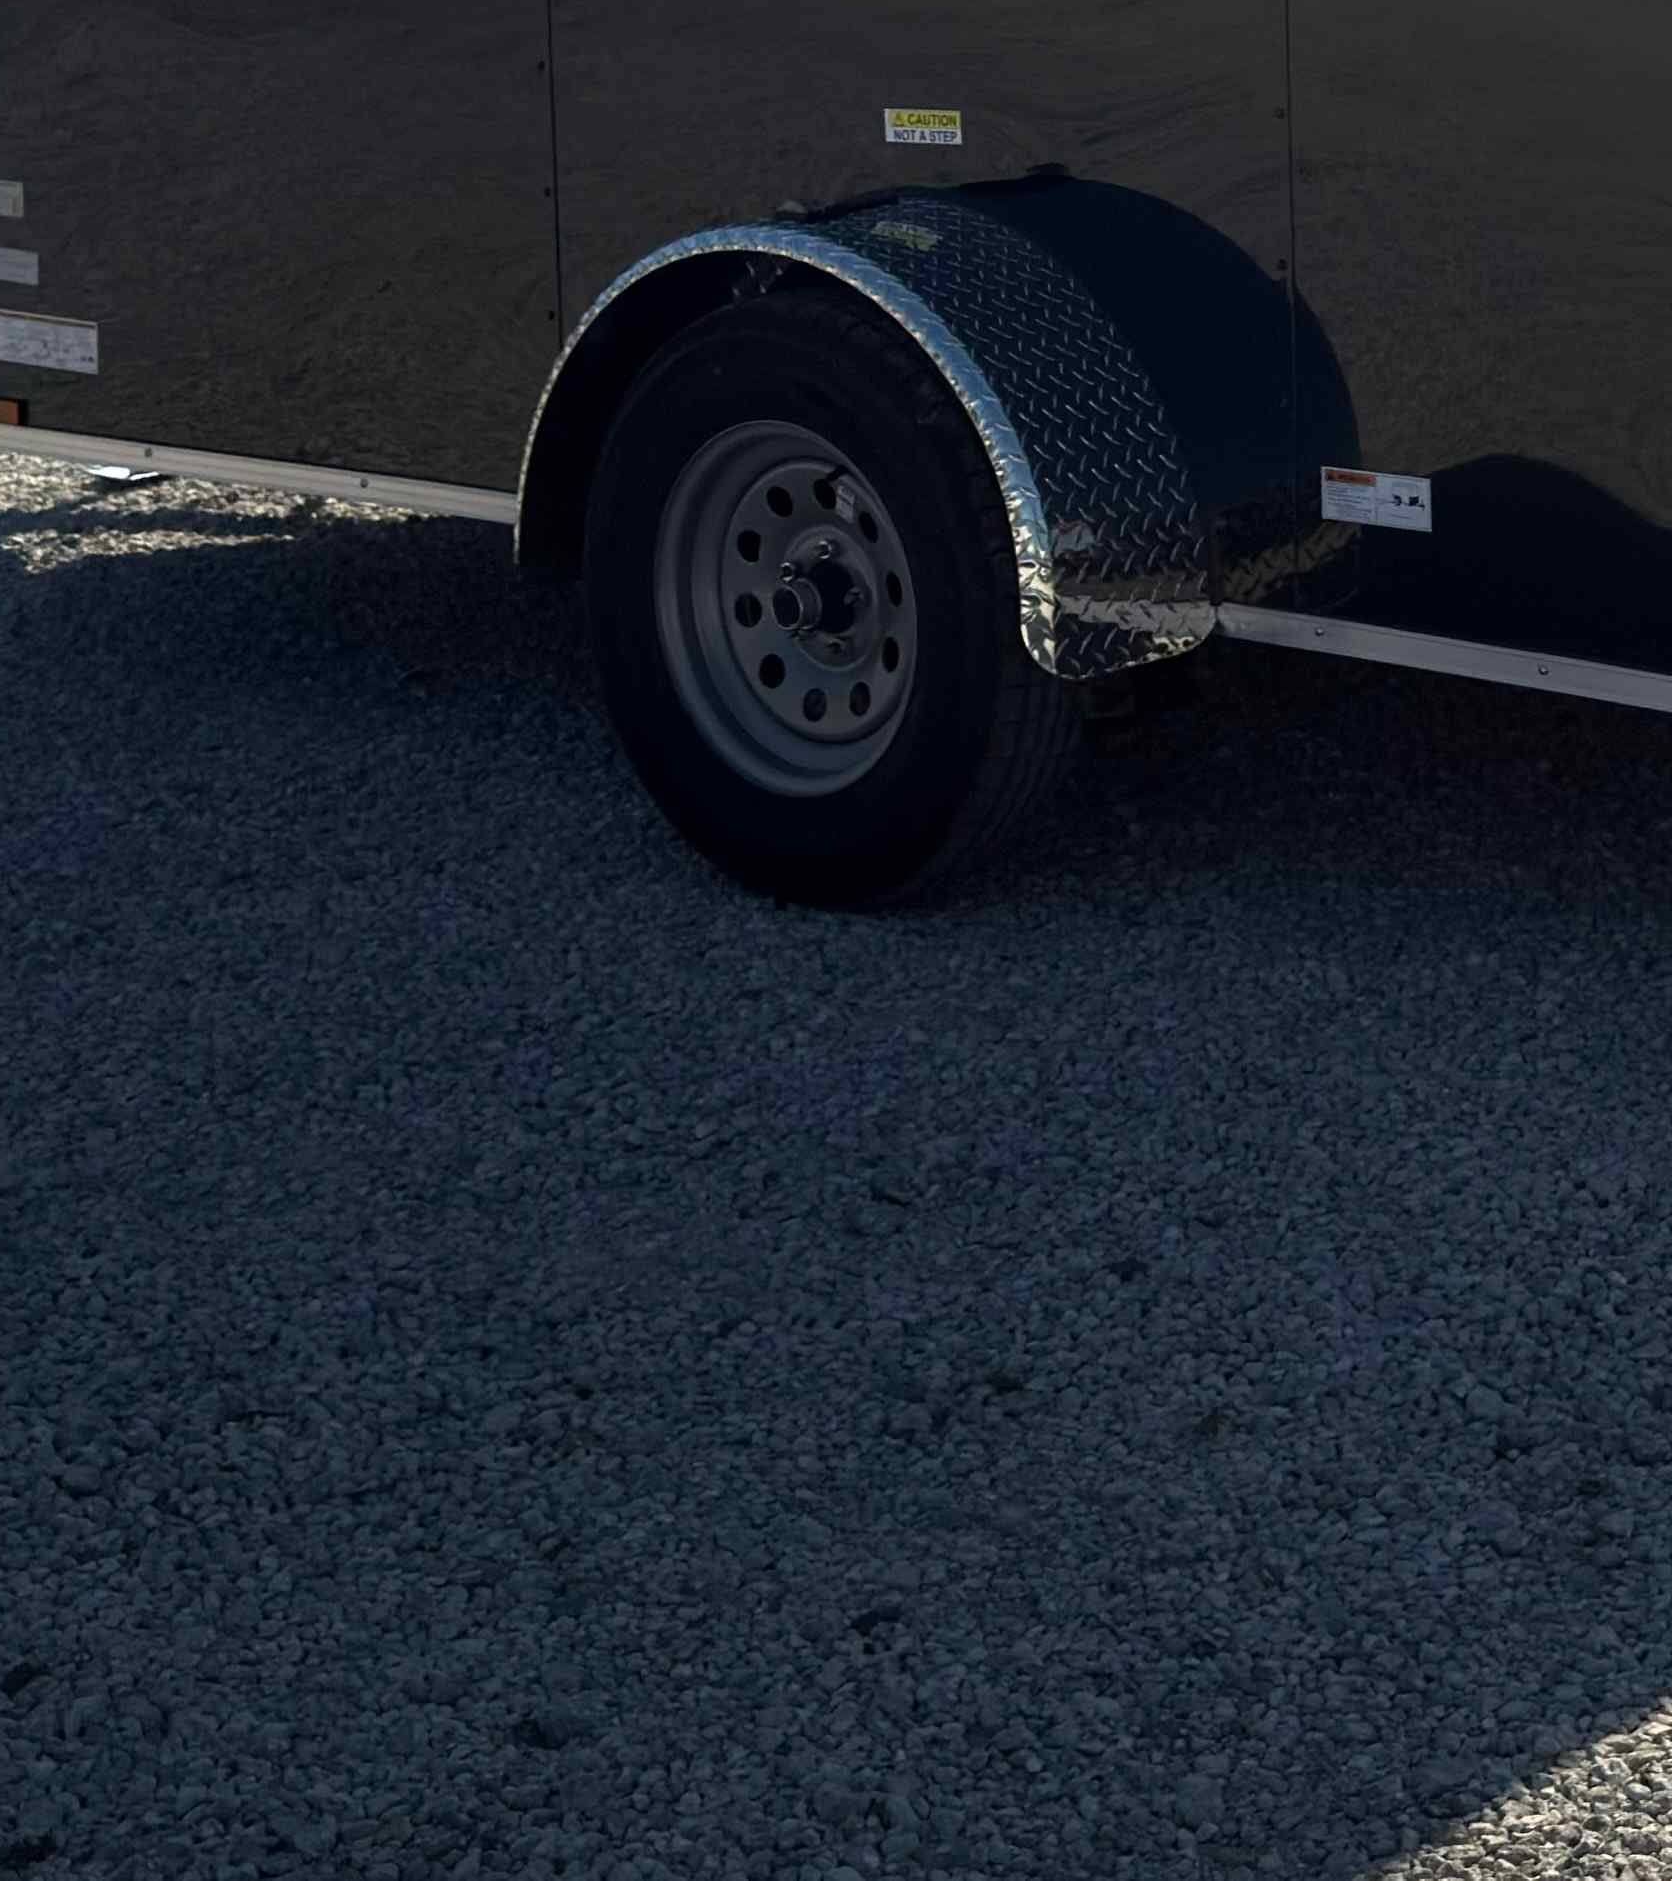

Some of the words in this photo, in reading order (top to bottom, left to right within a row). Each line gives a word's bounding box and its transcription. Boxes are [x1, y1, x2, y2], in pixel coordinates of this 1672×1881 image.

[907, 113, 958, 127] CAUTION
[894, 129, 916, 141] NOT
[919, 130, 928, 141] A
[930, 131, 958, 143] STEP
